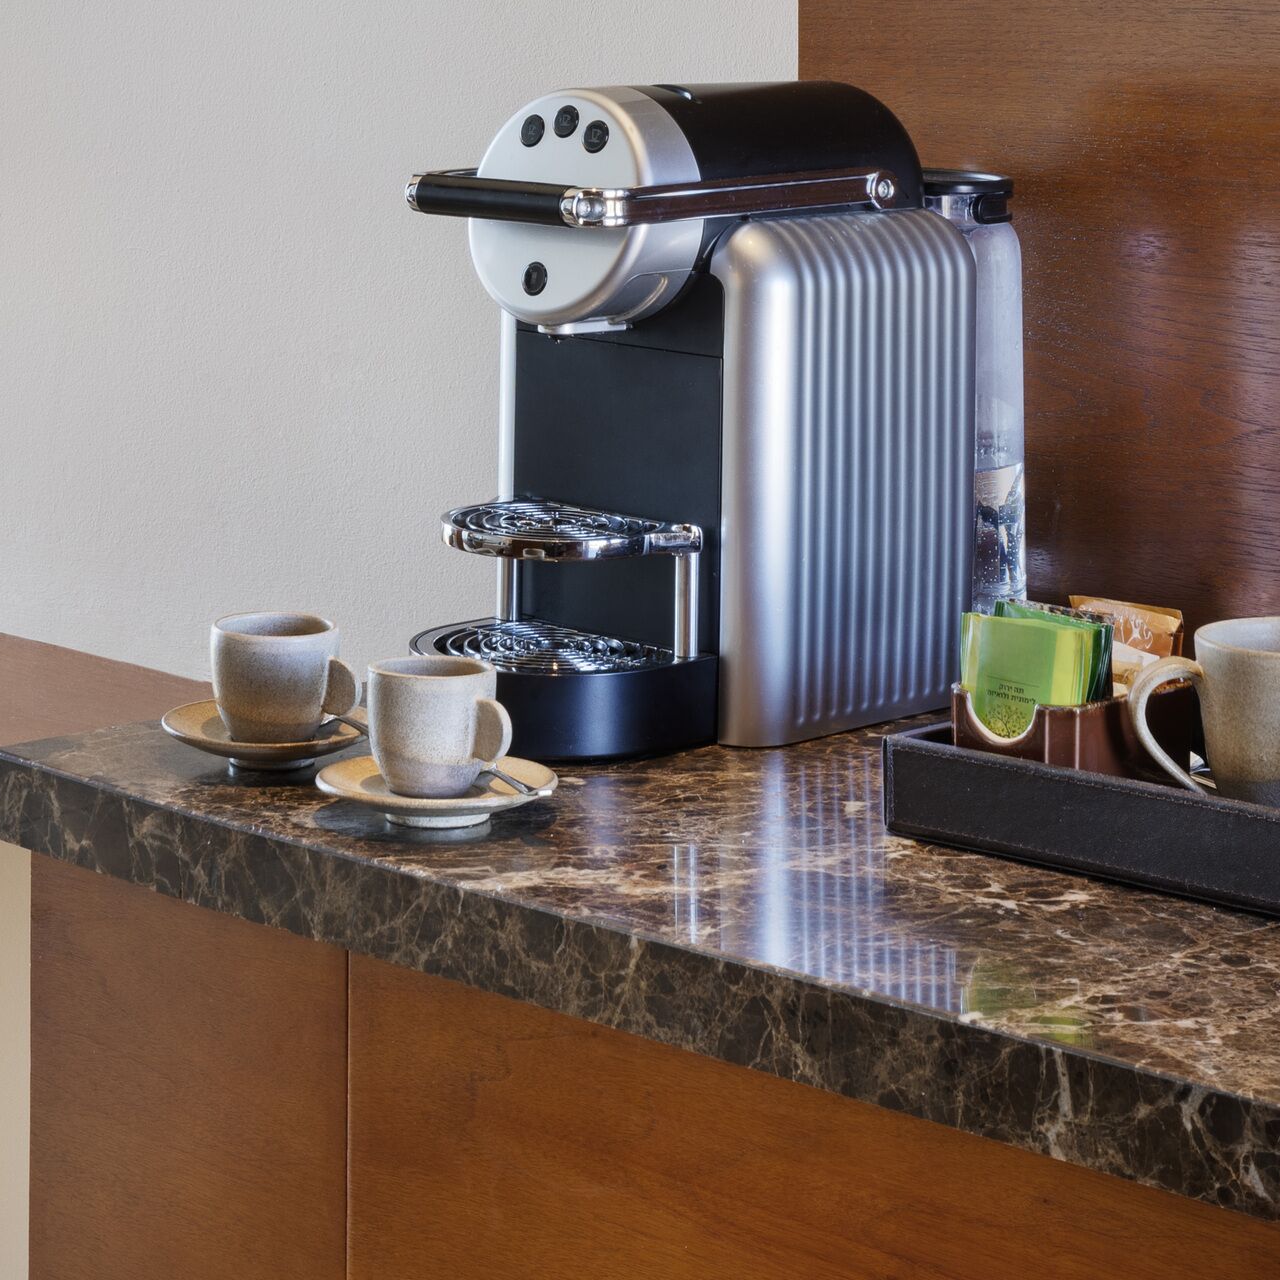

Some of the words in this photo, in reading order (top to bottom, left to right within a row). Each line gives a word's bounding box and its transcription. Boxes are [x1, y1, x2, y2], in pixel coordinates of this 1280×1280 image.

[998, 683, 1012, 692] ירוק
[1014, 686, 1024, 694] תה
[1010, 695, 1036, 705] לימונית
